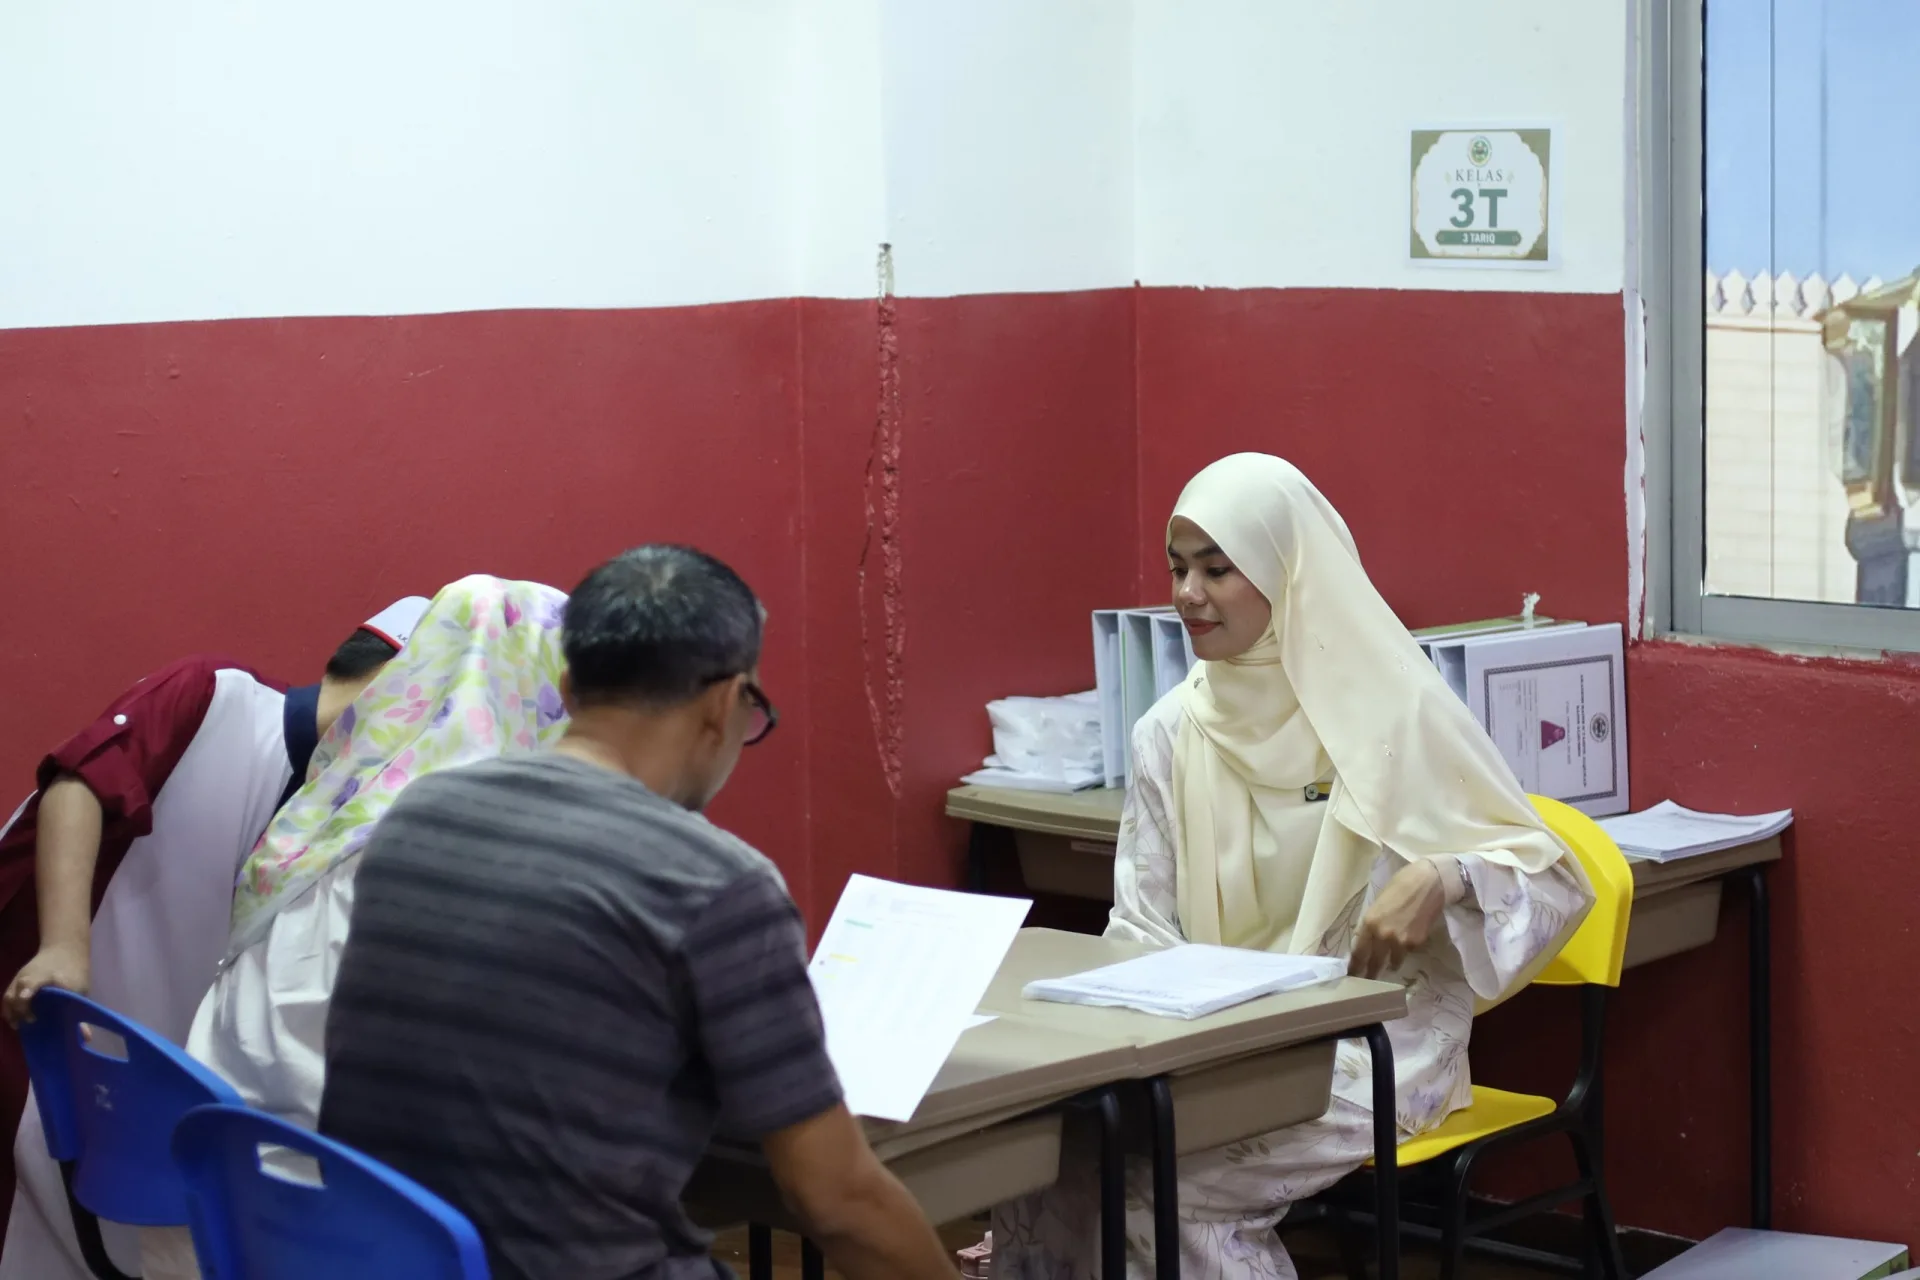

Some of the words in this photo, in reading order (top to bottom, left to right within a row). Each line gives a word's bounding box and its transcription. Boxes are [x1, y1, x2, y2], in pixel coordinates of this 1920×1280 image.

[1455, 169, 1503, 182] KELAS
[1449, 187, 1508, 228] 3T
[1462, 233, 1469, 243] 3
[1470, 233, 1496, 244] TARIQ
